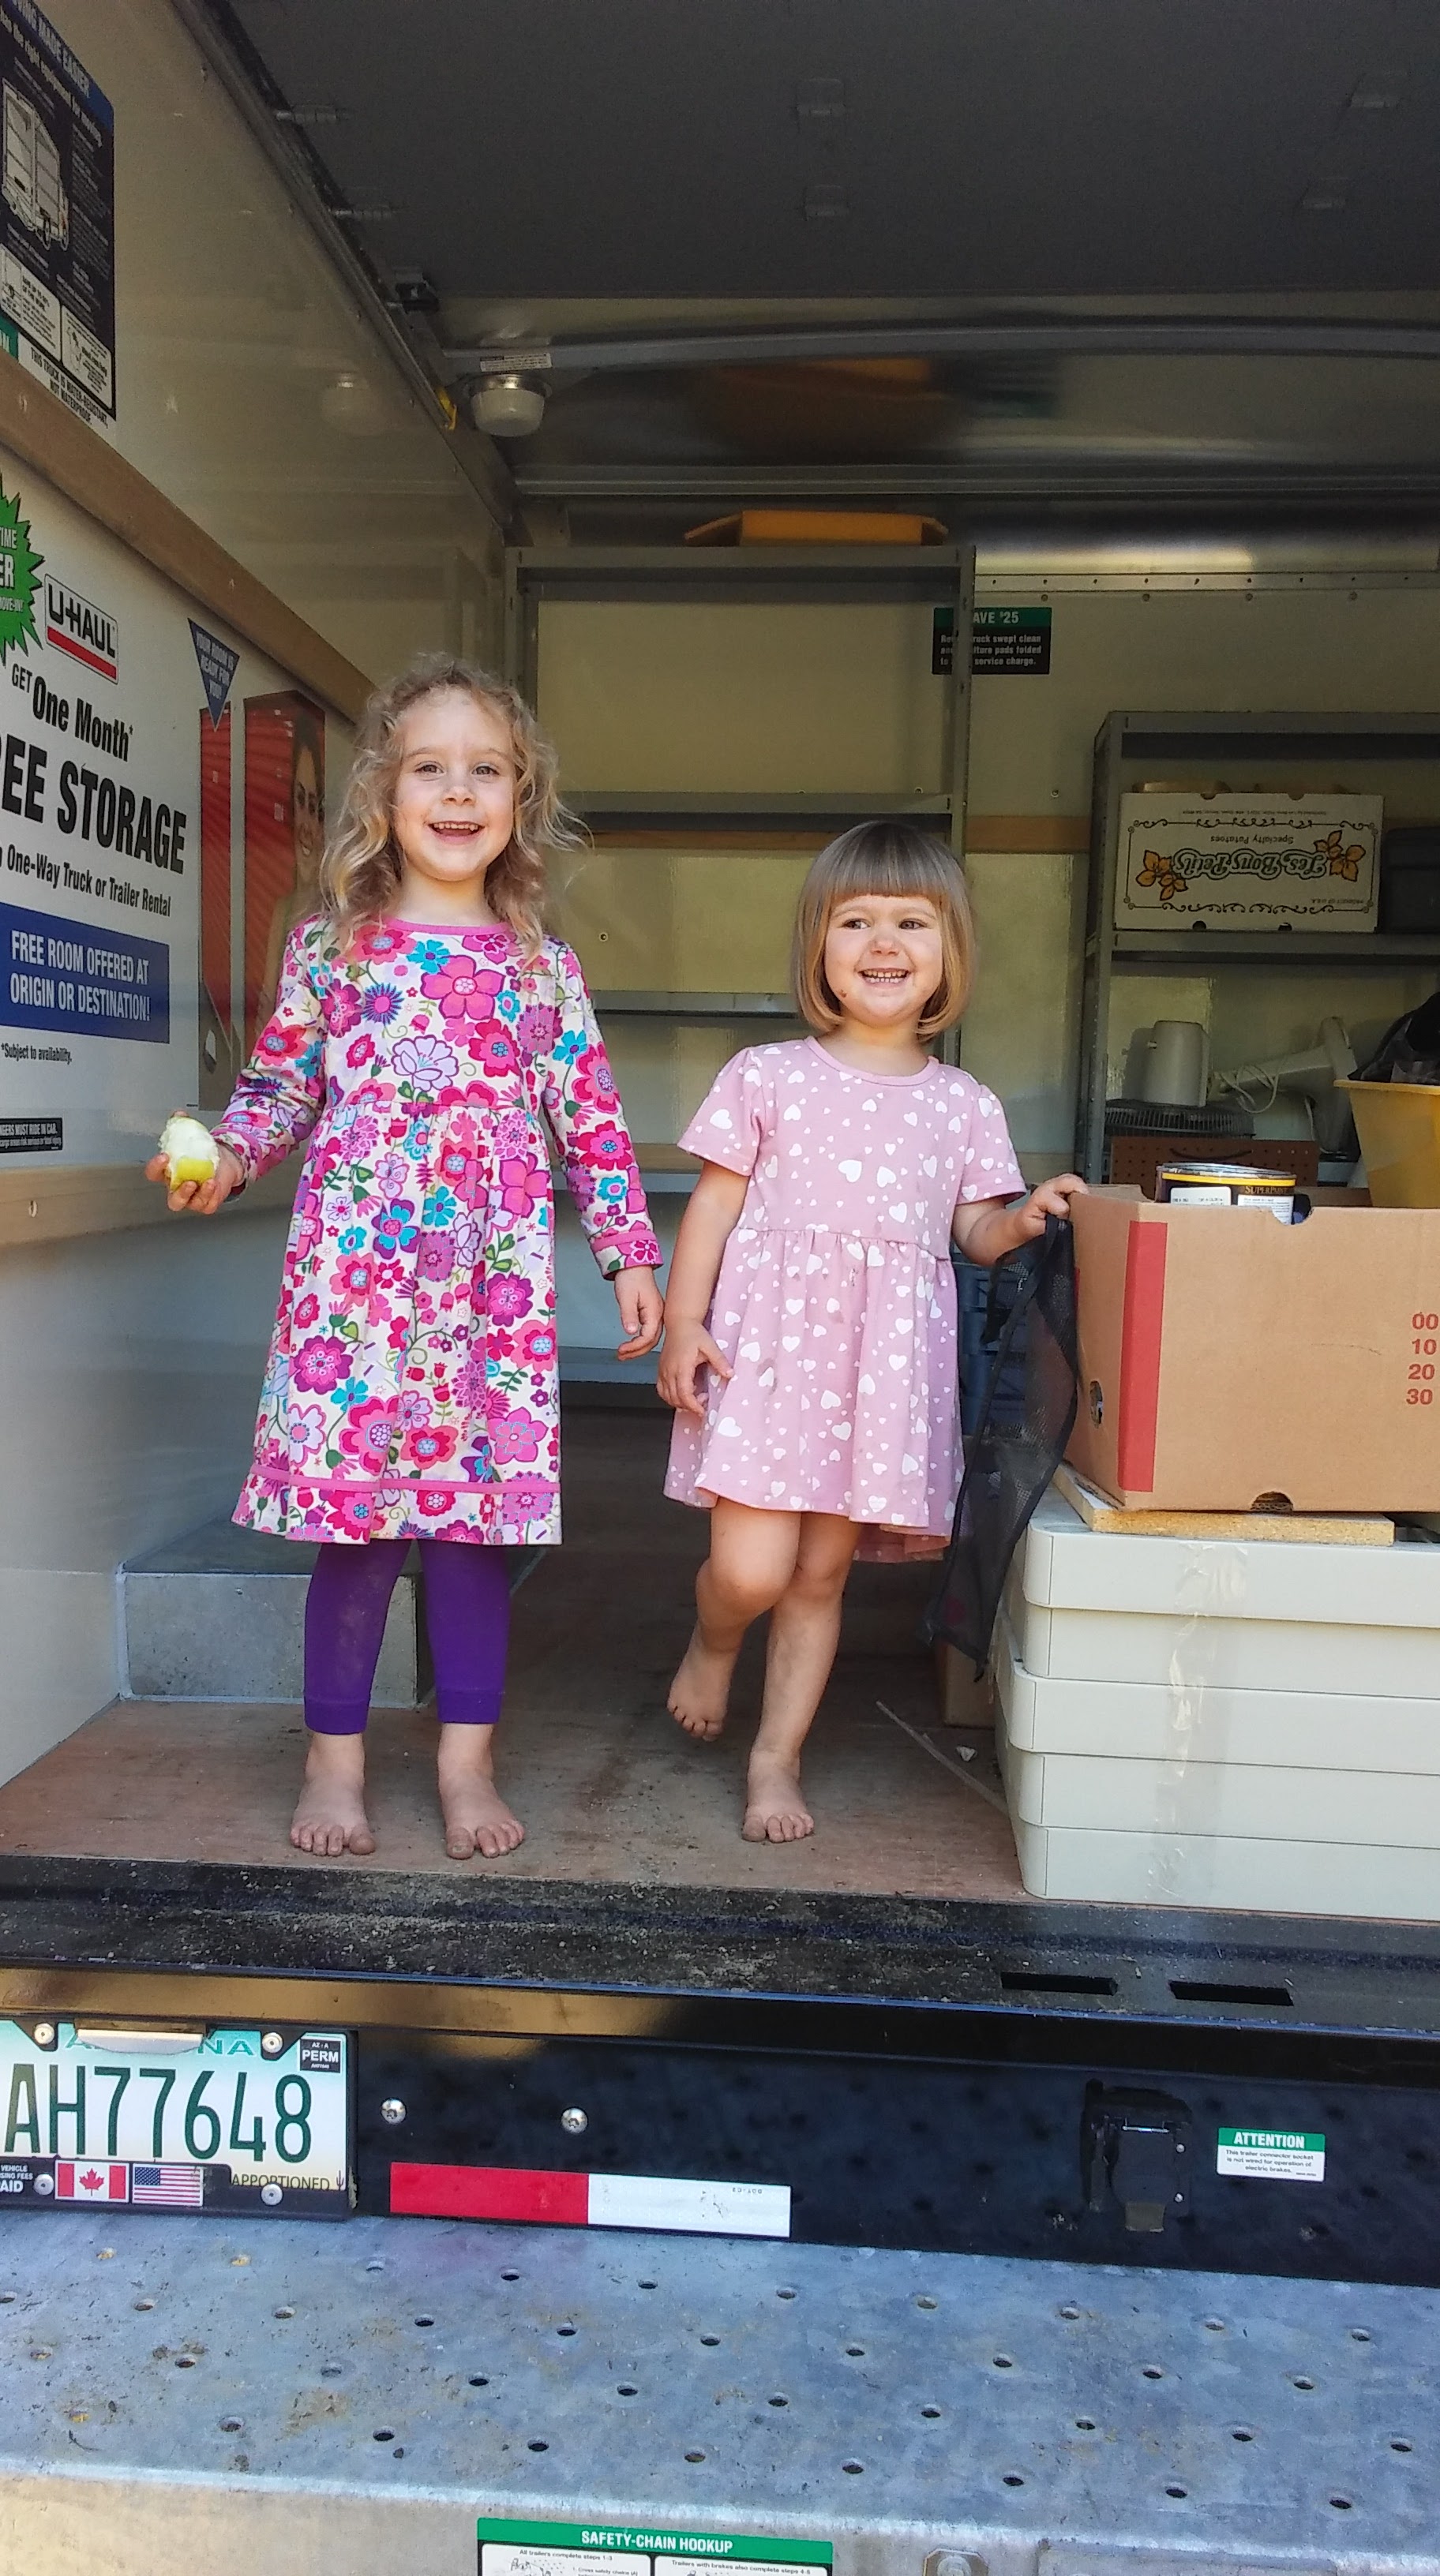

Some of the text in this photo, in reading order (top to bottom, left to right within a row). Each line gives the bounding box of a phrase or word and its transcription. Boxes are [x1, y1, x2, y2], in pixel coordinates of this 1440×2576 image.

[39, 17, 62, 63] MADE
[63, 47, 91, 99] EASIER
[48, 583, 116, 658] U-HAUL
[973, 611, 996, 624] AVE
[973, 635, 1042, 645] ruck swept clean
[995, 646, 1014, 656] pads
[1016, 646, 1042, 654] folded
[974, 657, 1005, 666] service
[1006, 657, 1037, 667] charge.
[12, 664, 33, 694] GET
[32, 676, 69, 732] One
[0, 733, 187, 874] EE STORAGE
[1210, 834, 1294, 844] Specialty Potatoes
[7, 844, 60, 889] One-Way
[63, 862, 92, 894] Truck
[95, 878, 107, 898] or
[109, 876, 140, 908] Trailer
[141, 888, 171, 918] Rental
[11, 930, 149, 986] FREE ROOM OFFERED AT
[10, 972, 151, 1022] ORIGIN OR DESTINATION!
[30, 1045, 37, 1061] to
[1412, 1313, 1438, 1330] 00
[1412, 1339, 1437, 1355] 10
[1408, 1364, 1435, 1380] 20
[1406, 1388, 1433, 1405] 30
[302, 2050, 339, 2063] PERM
[4, 2062, 312, 2163] AH77648
[1233, 2132, 1305, 2149] ATTENTION
[0, 2180, 24, 2192] AID
[232, 2174, 330, 2191] APPORTIONED
[581, 2530, 733, 2554] SAFETY-CHAIN HOOKUP
